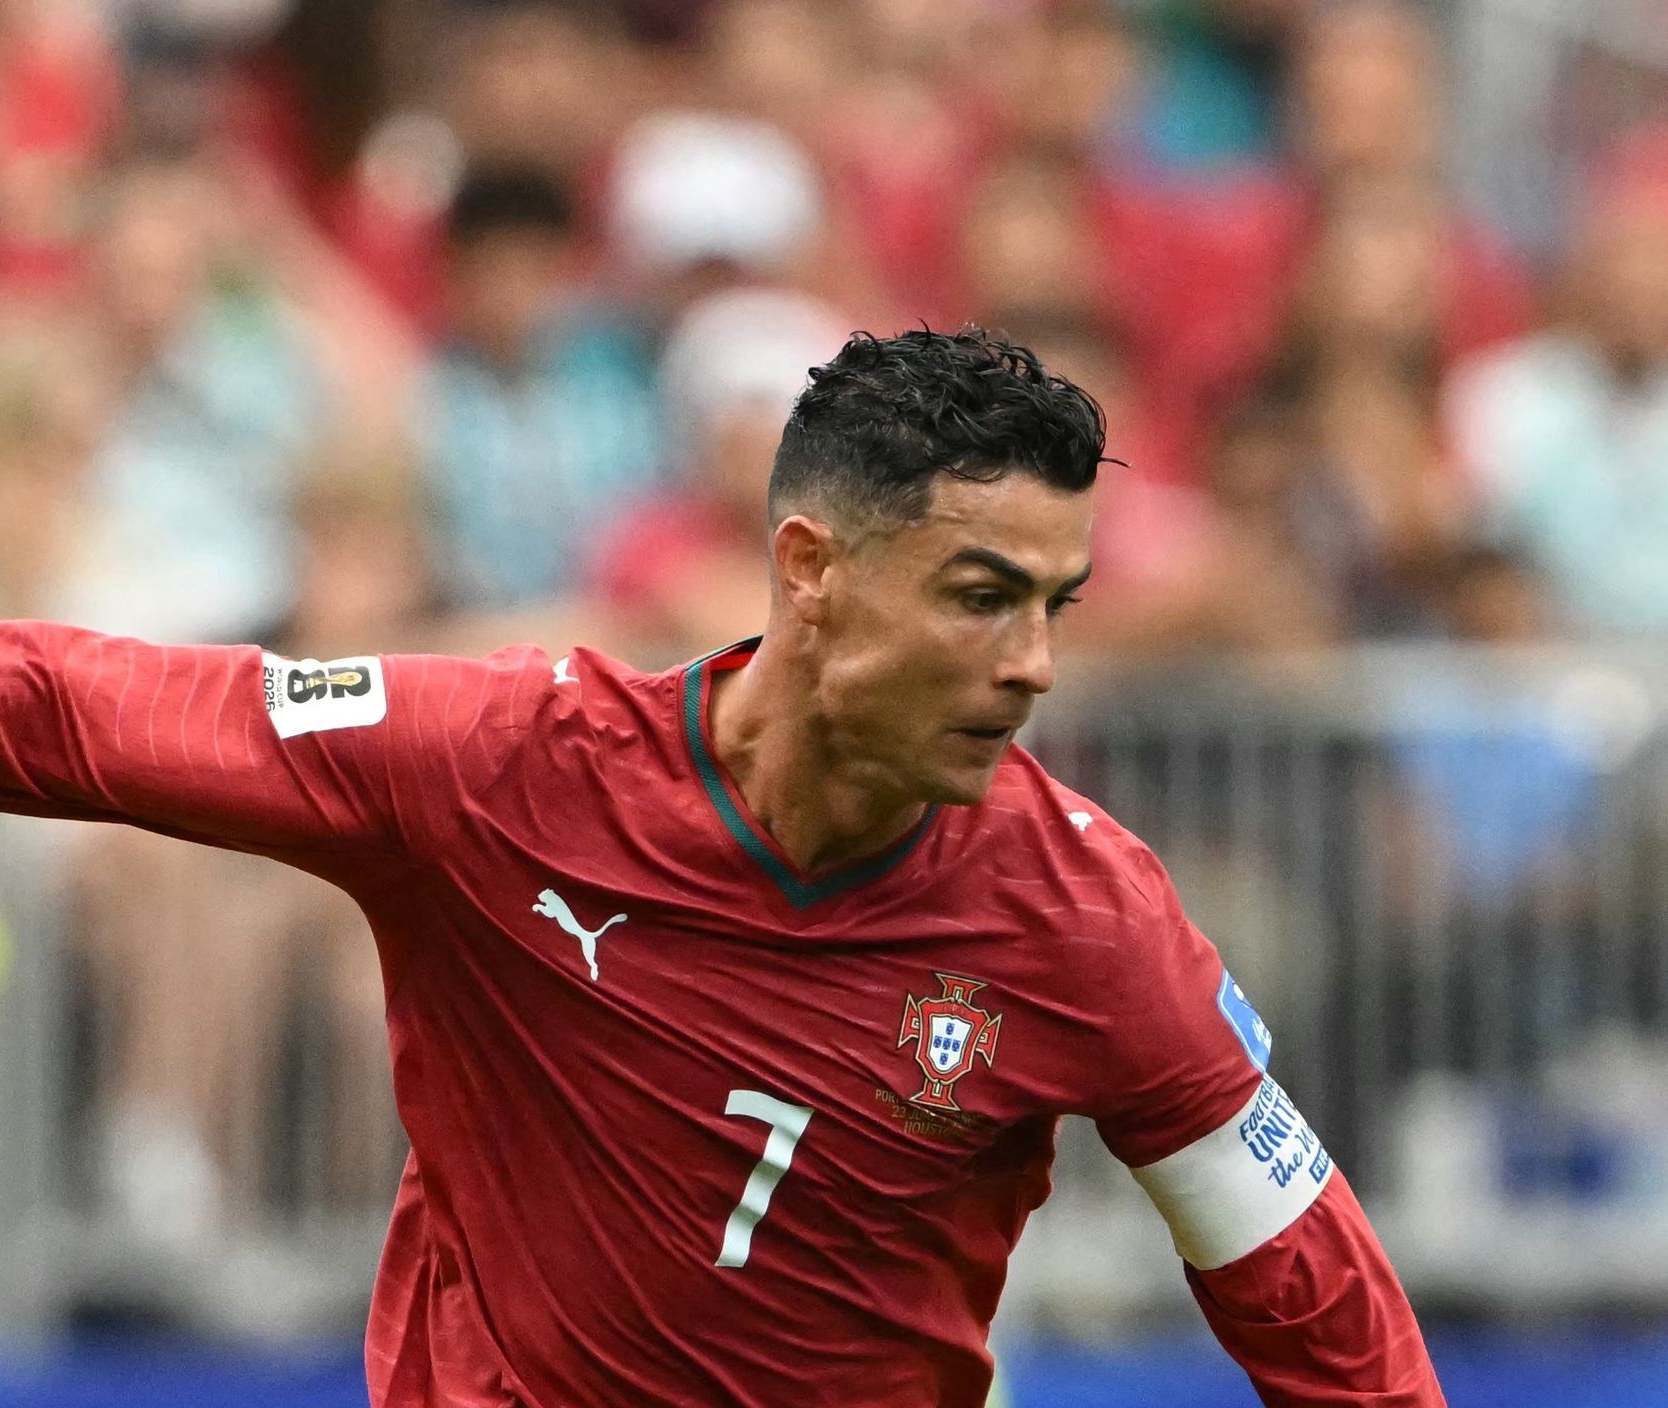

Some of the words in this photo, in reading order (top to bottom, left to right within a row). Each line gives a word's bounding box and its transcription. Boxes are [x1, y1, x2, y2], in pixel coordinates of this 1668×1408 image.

[263, 666, 276, 712] 2026
[1239, 1078, 1277, 1143] FOOTBA
[714, 1089, 815, 1268] 7
